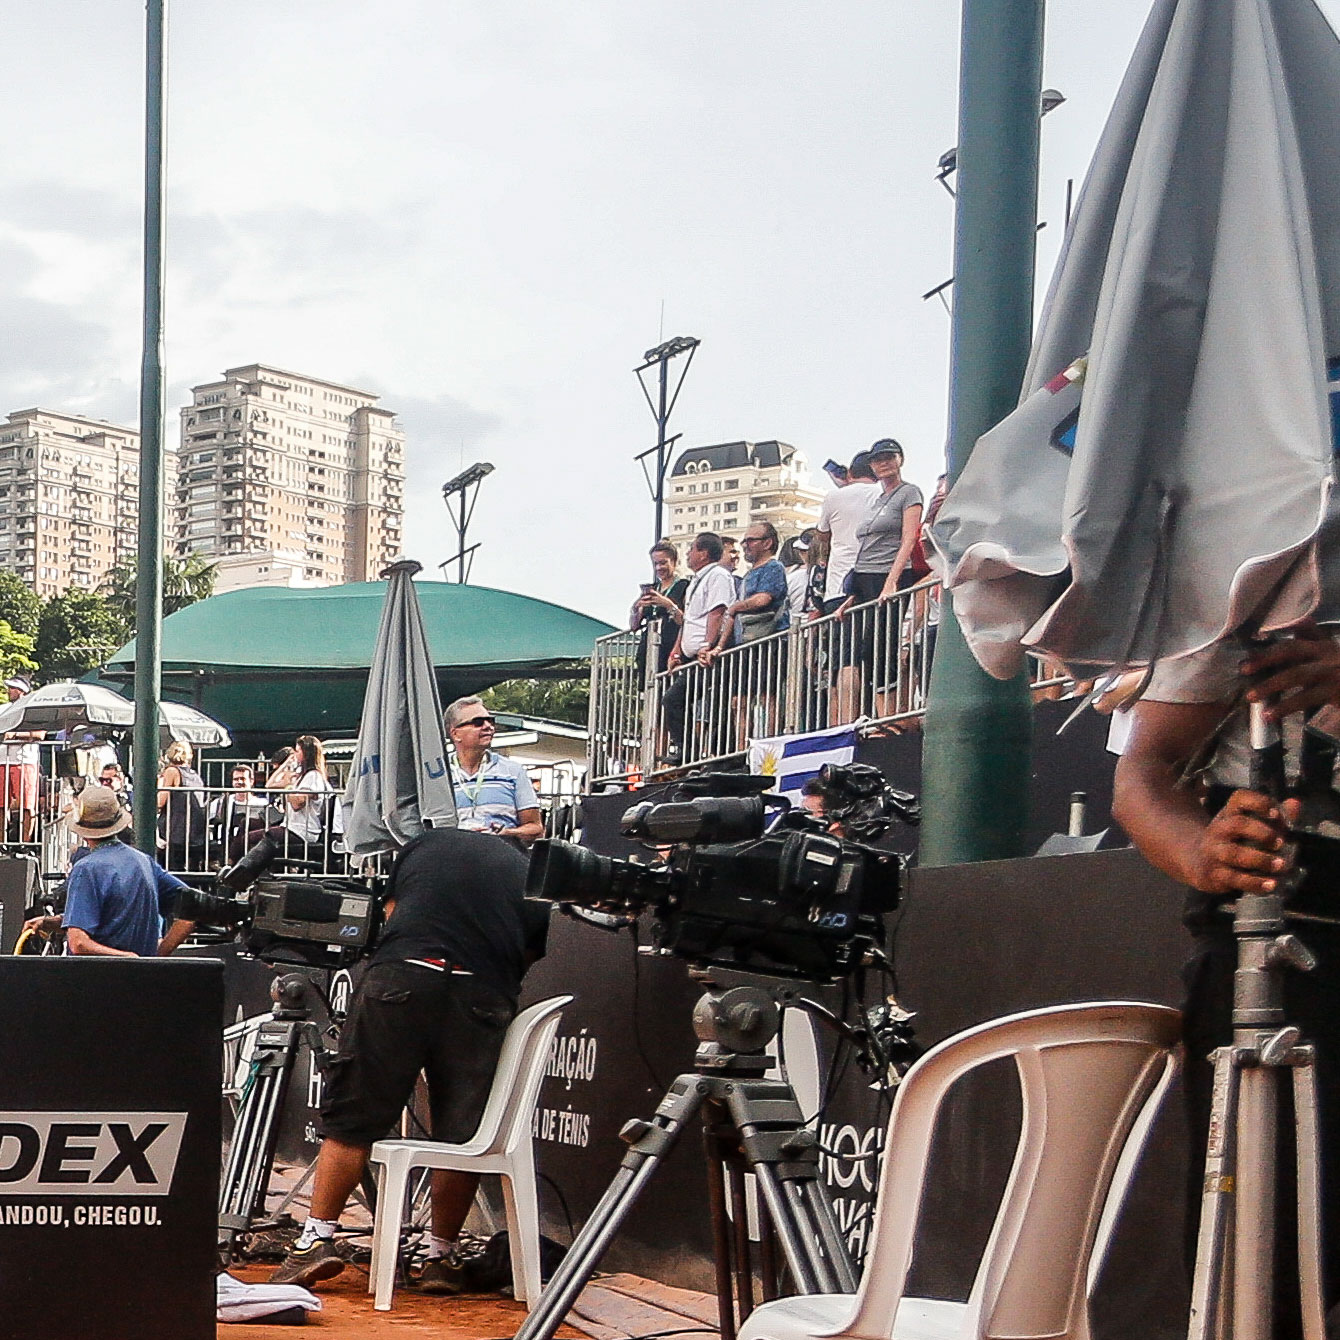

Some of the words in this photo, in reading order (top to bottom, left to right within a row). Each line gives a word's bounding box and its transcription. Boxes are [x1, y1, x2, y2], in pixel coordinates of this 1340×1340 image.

[541, 1108, 557, 1142] DE
[558, 1104, 590, 1148] TÊNIS
[73, 1206, 163, 1226] CHEGOU.
